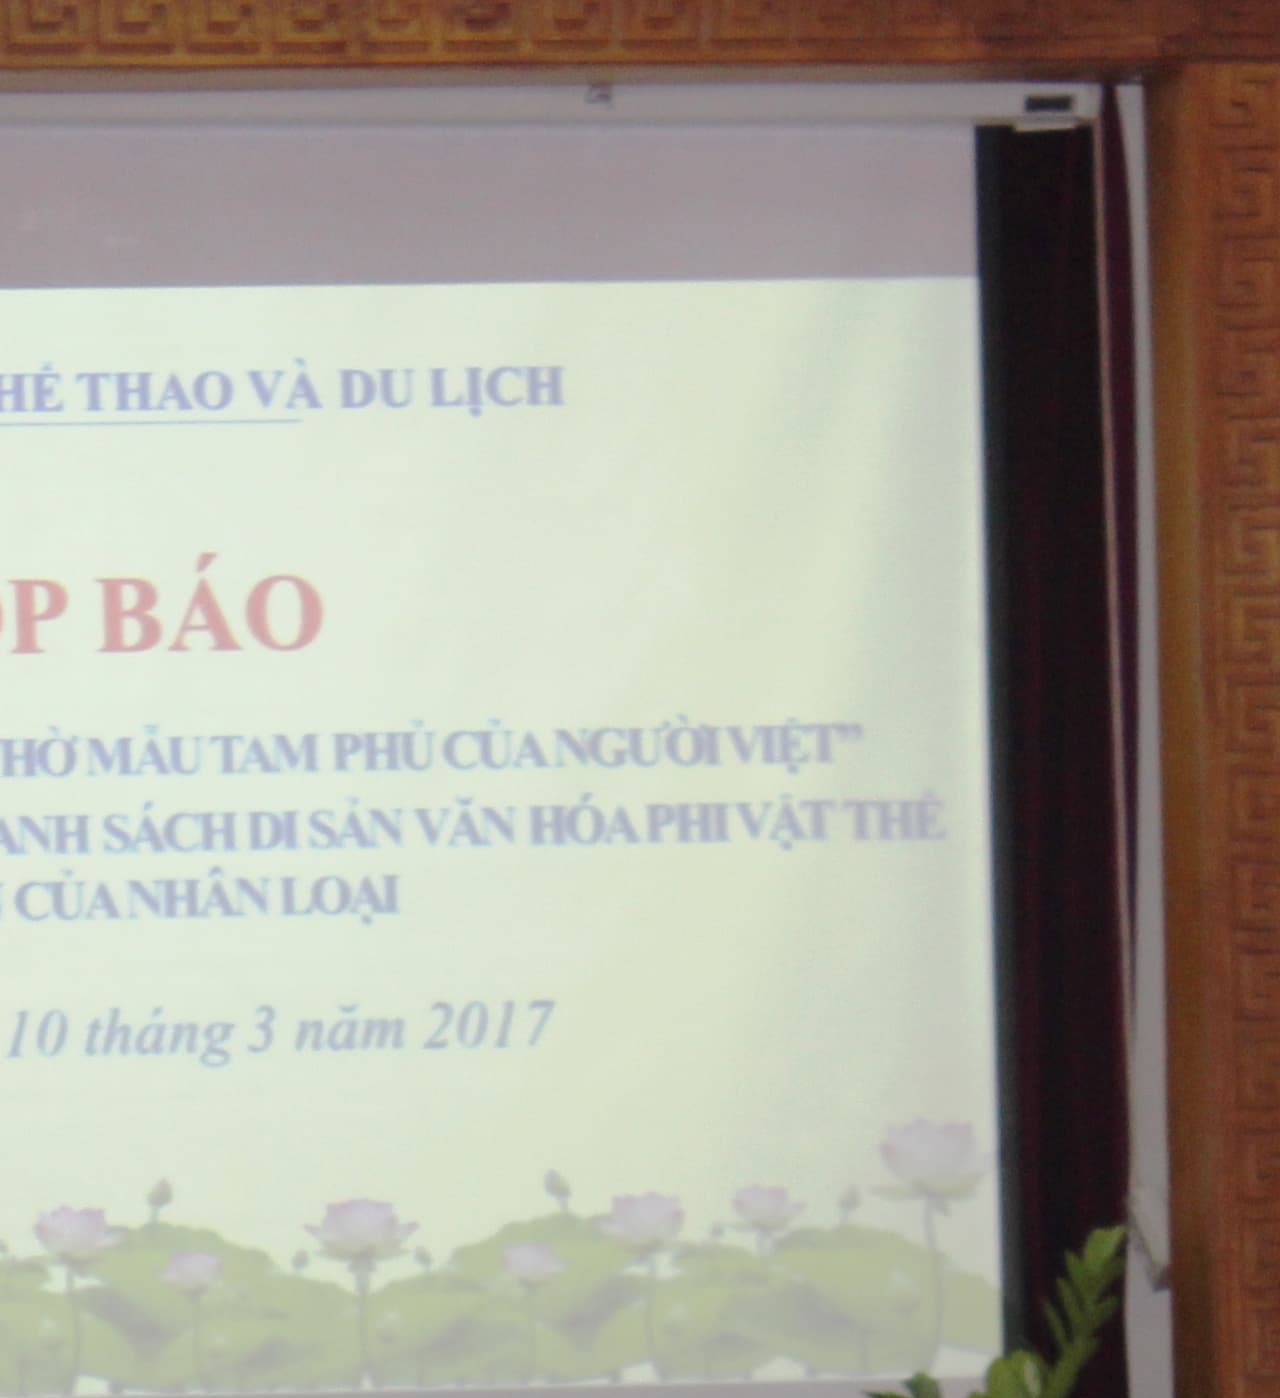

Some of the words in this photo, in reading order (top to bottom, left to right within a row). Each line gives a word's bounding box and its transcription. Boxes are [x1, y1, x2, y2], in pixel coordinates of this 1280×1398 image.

[75, 370, 235, 412] THAO
[246, 357, 322, 411] VÀ
[339, 368, 415, 409] DU
[430, 365, 565, 417] LỊCH
[96, 552, 325, 655] BÁO
[86, 724, 202, 777] MẪU
[209, 733, 320, 774] TAM
[333, 718, 434, 772] PHỦ
[443, 717, 548, 770] CỦA
[554, 713, 724, 769] NGƯỜI
[102, 800, 236, 854] SÁCH
[248, 811, 300, 850] DI
[308, 796, 404, 849] SẢN
[414, 794, 517, 847] VĂN
[528, 792, 638, 845] HÓA
[646, 800, 731, 843] PHI
[735, 794, 835, 851] VẬT
[842, 786, 947, 842] THỂ
[14, 867, 120, 921] CỦA
[127, 866, 271, 920] NHÂN
[280, 872, 401, 925] LOẠI
[4, 1009, 70, 1059] 10
[83, 1006, 236, 1070] tháng
[247, 1004, 276, 1054] 3
[293, 1003, 406, 1053] năm
[422, 1000, 557, 1050] 2017
